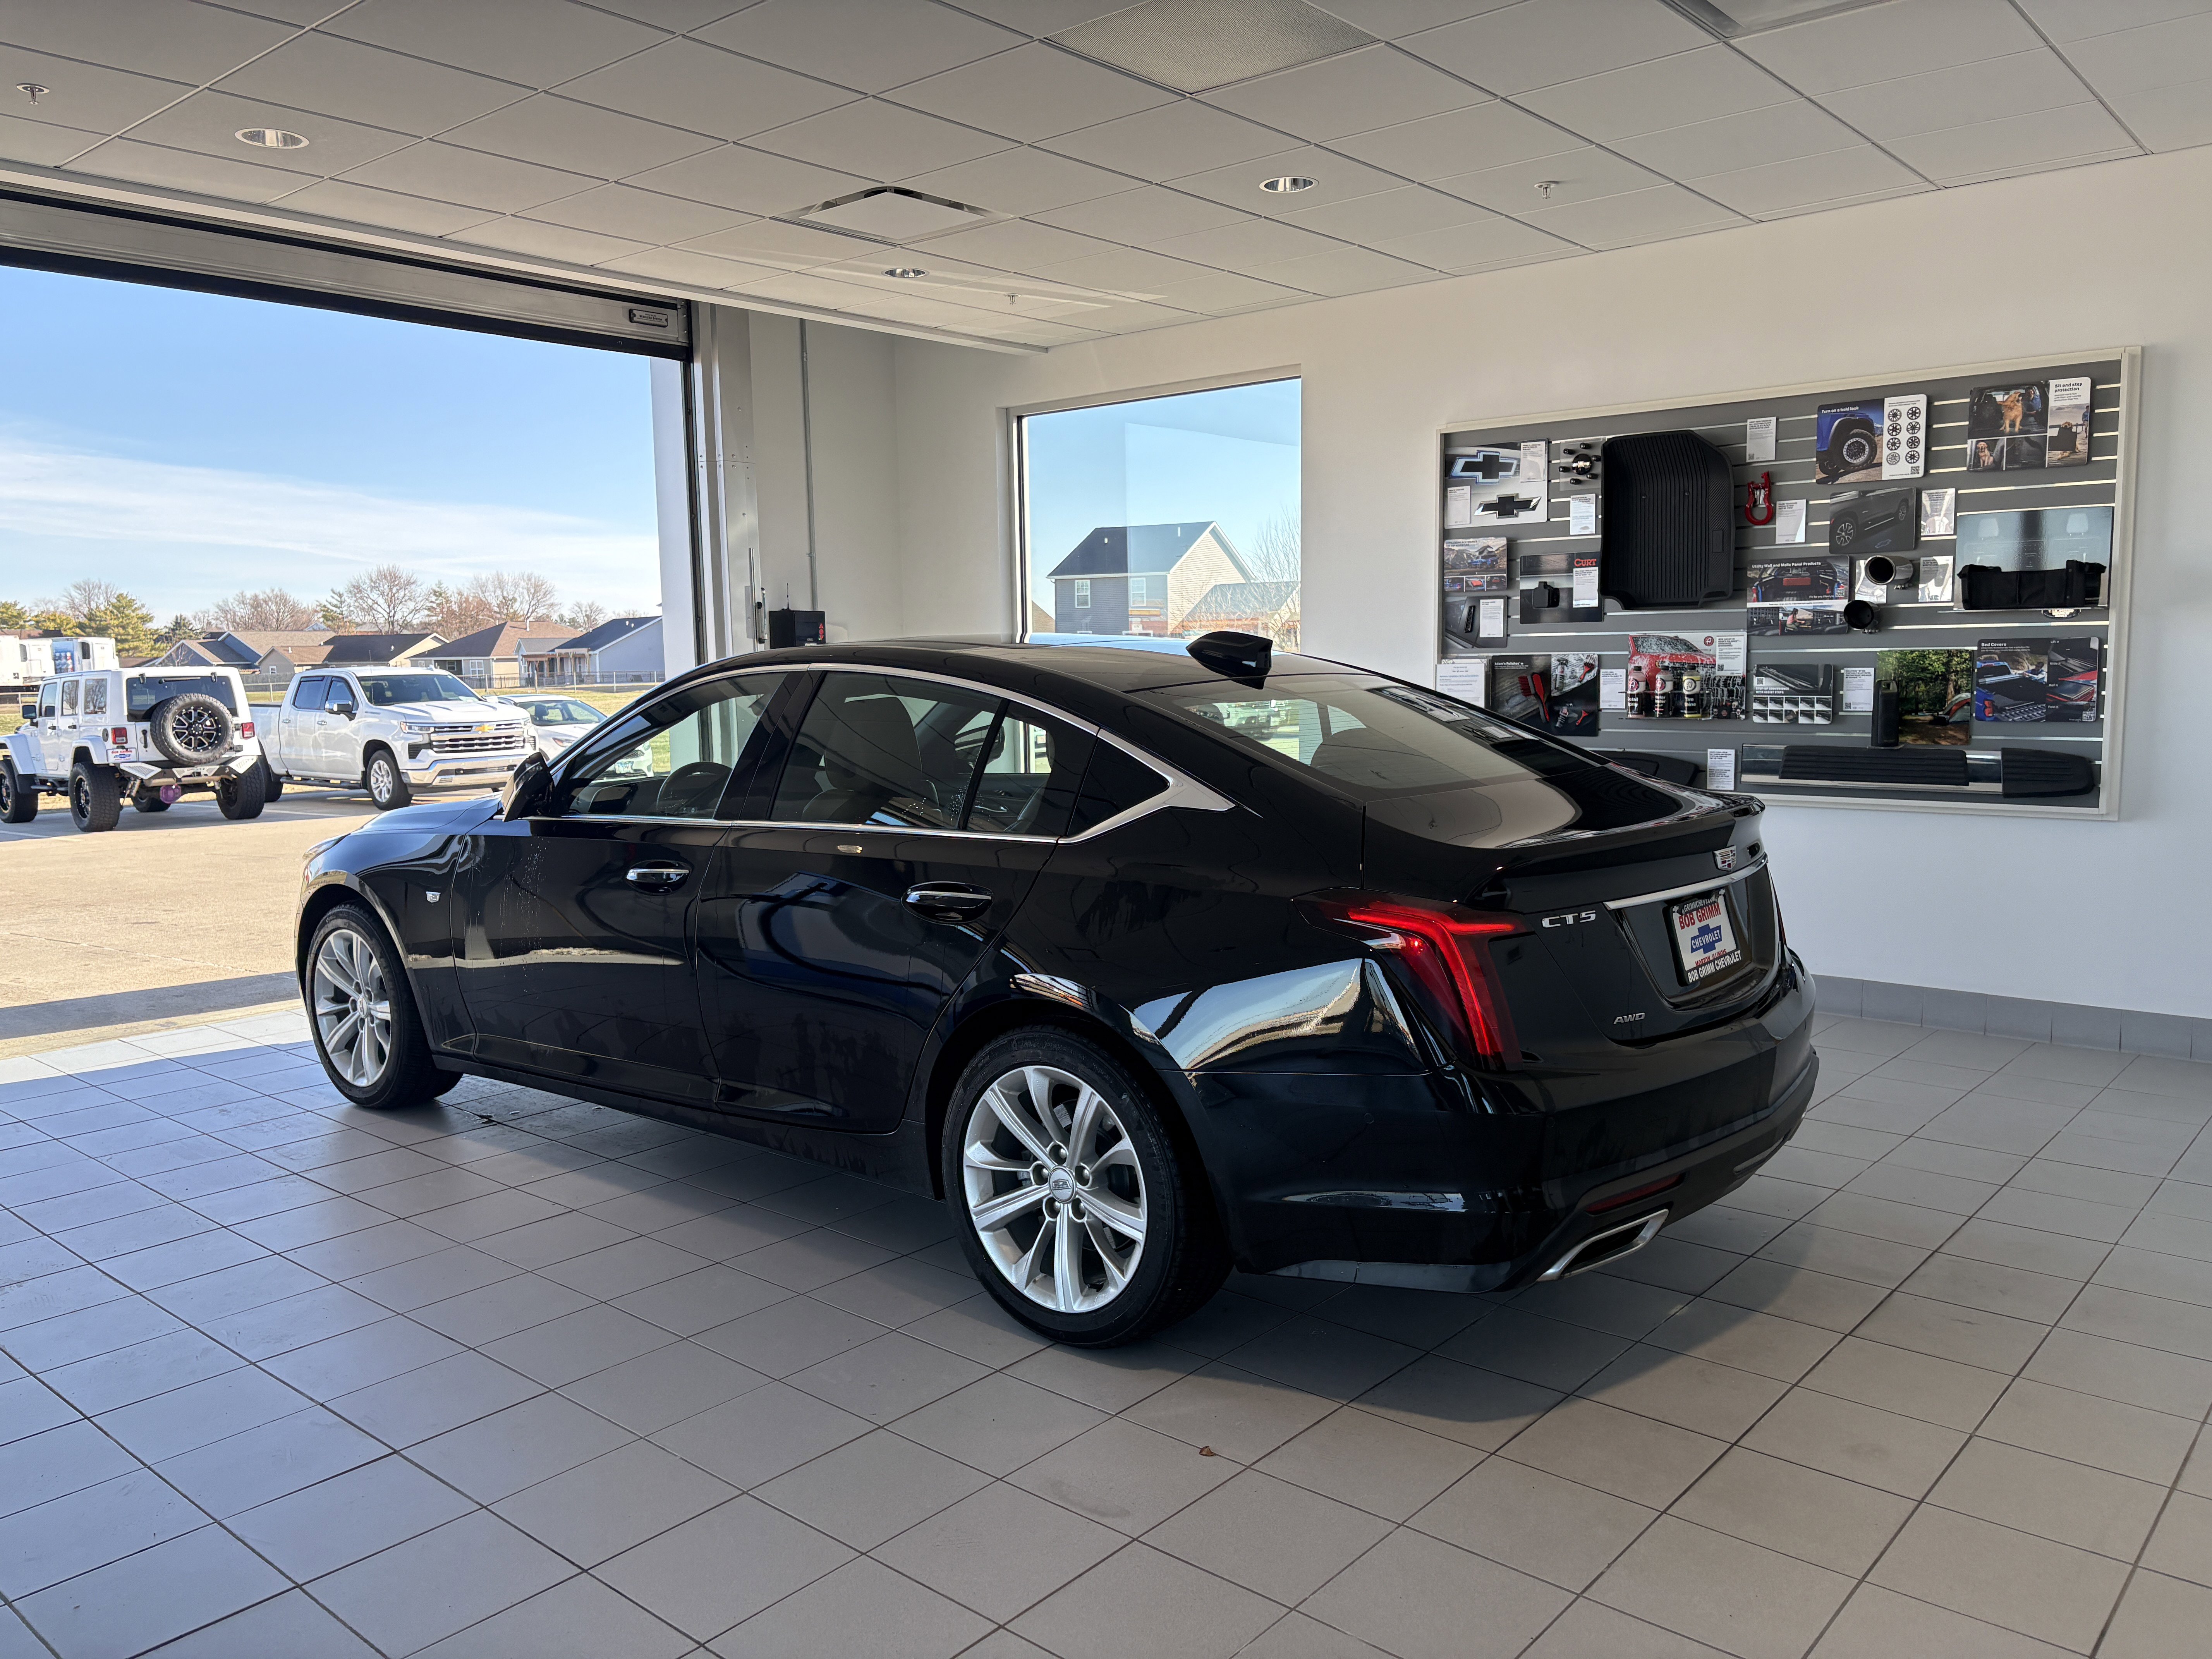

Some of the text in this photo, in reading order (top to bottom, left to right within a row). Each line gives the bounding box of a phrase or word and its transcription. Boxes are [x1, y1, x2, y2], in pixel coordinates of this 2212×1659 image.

[1574, 558, 1597, 567] CURT
[1542, 910, 1596, 928] CT5
[1679, 902, 1721, 930] BOB GRIMM
[1692, 929, 1721, 949] CHEVROLET
[1688, 950, 1741, 983] BOB GRIMM CHEVROLET
[1613, 1012, 1645, 1024] AWD
